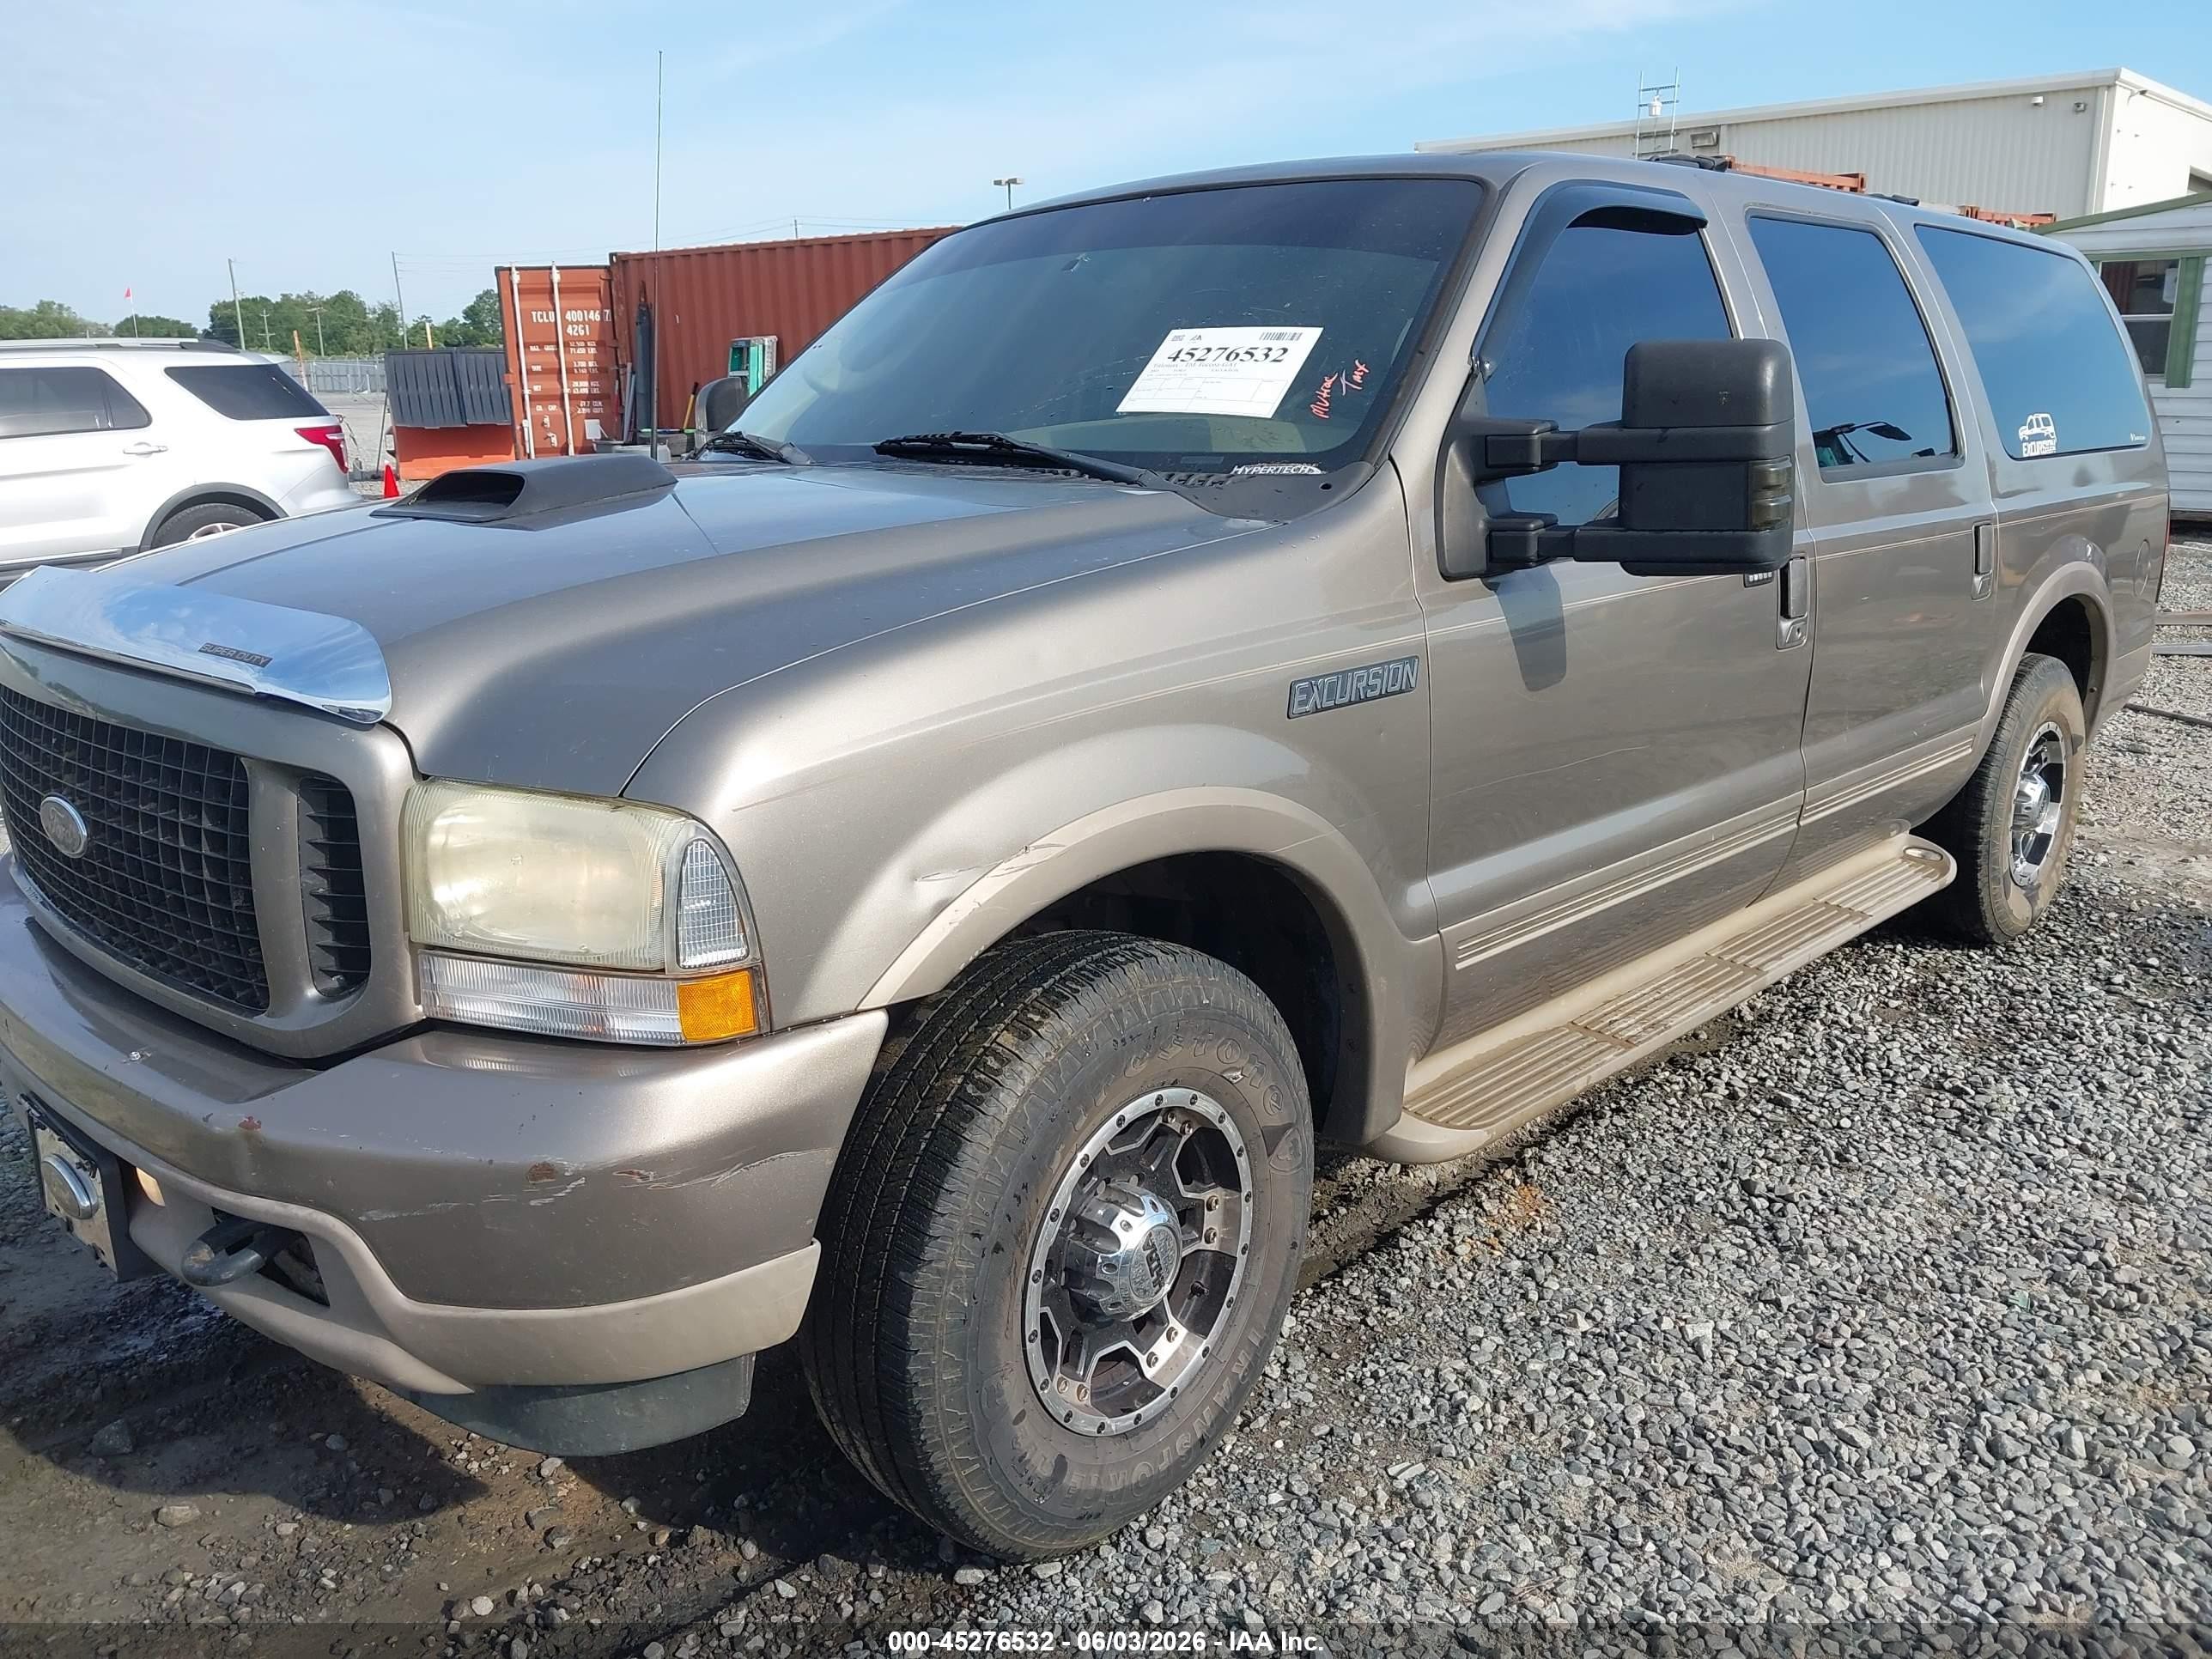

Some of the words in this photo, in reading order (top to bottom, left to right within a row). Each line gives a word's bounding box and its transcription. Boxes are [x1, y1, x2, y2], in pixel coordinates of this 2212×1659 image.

[531, 311, 556, 322] TCLU
[565, 310, 601, 322] 400146
[604, 309, 611, 321] 7
[567, 325, 590, 336] 42G1
[1168, 346, 1289, 362] 45276532
[1230, 465, 1310, 475] HYPERTECH
[201, 643, 234, 657] SUPER
[235, 651, 269, 665] DUTY
[1292, 659, 1419, 715] EXCURSION
